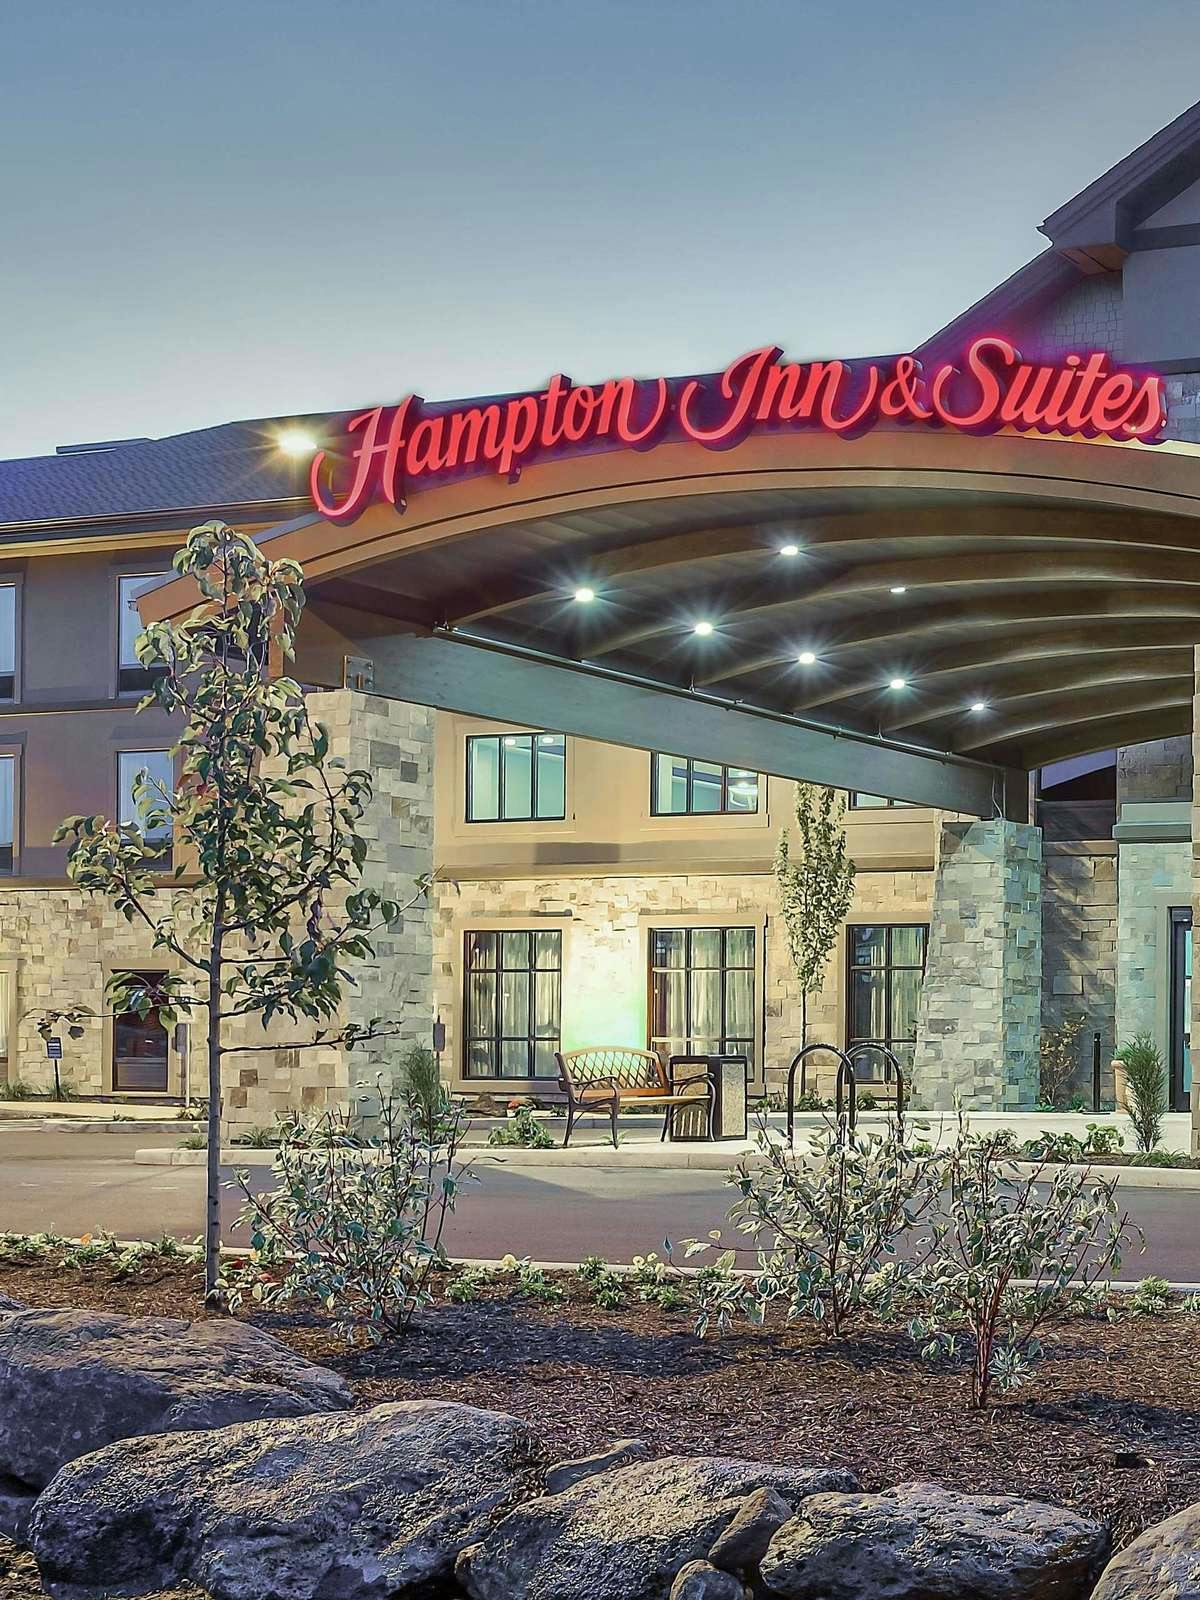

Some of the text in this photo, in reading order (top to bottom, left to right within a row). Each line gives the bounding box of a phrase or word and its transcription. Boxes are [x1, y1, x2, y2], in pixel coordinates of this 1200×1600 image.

[311, 337, 1167, 517] Hampton Inn & Suites
